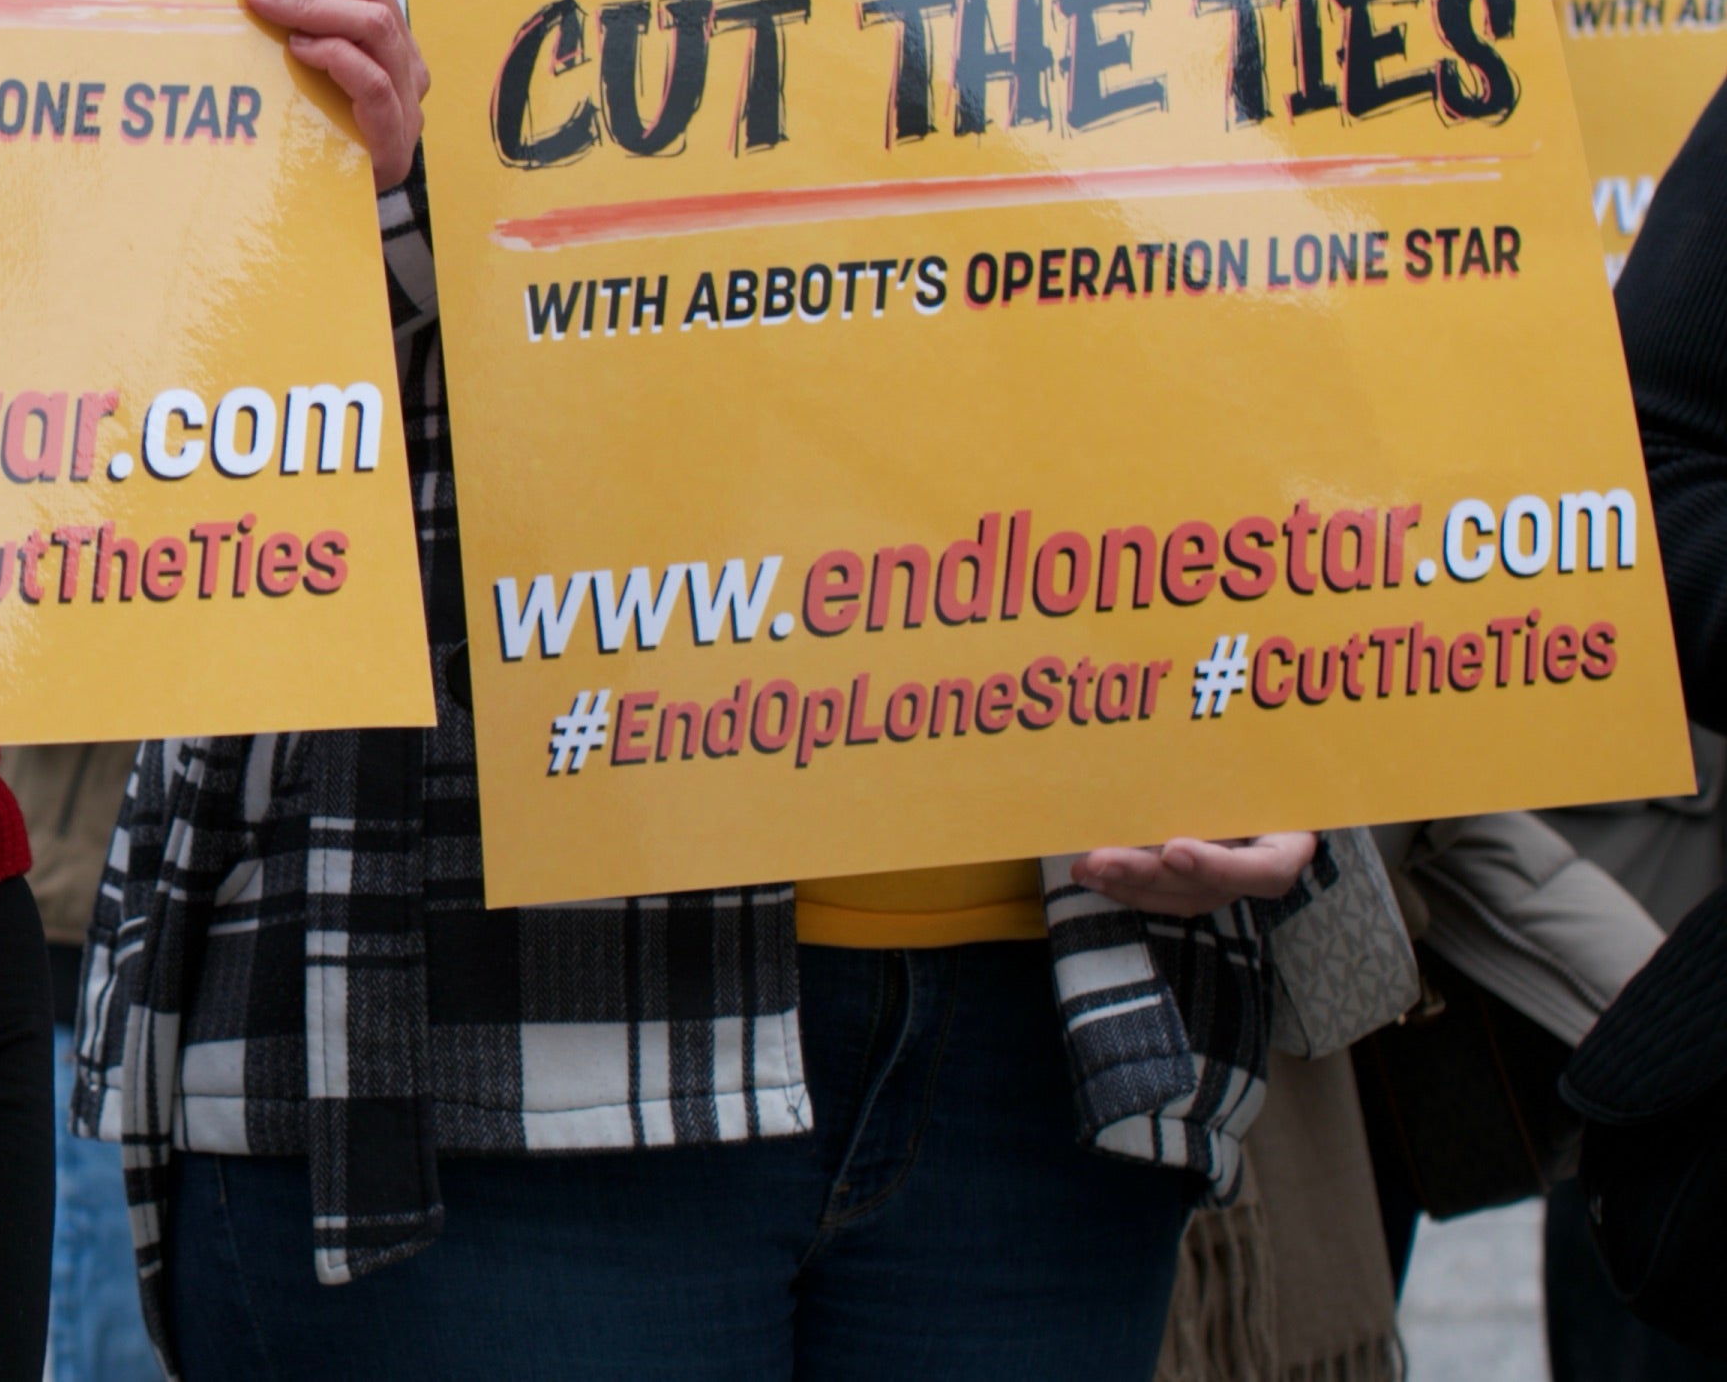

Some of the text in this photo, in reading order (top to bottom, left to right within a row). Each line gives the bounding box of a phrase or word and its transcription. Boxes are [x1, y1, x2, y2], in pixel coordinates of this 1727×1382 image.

[120, 81, 263, 147] STAR
[524, 274, 670, 343] WITH
[680, 254, 949, 333] ABBOTT'S
[964, 236, 1250, 311] OPERATION
[1267, 230, 1390, 290] LONE
[1404, 224, 1522, 283] STAR
[493, 485, 1638, 663] www.endlonestar.com
[545, 606, 1619, 777] #EndOpLoneStar #CutTheTies
